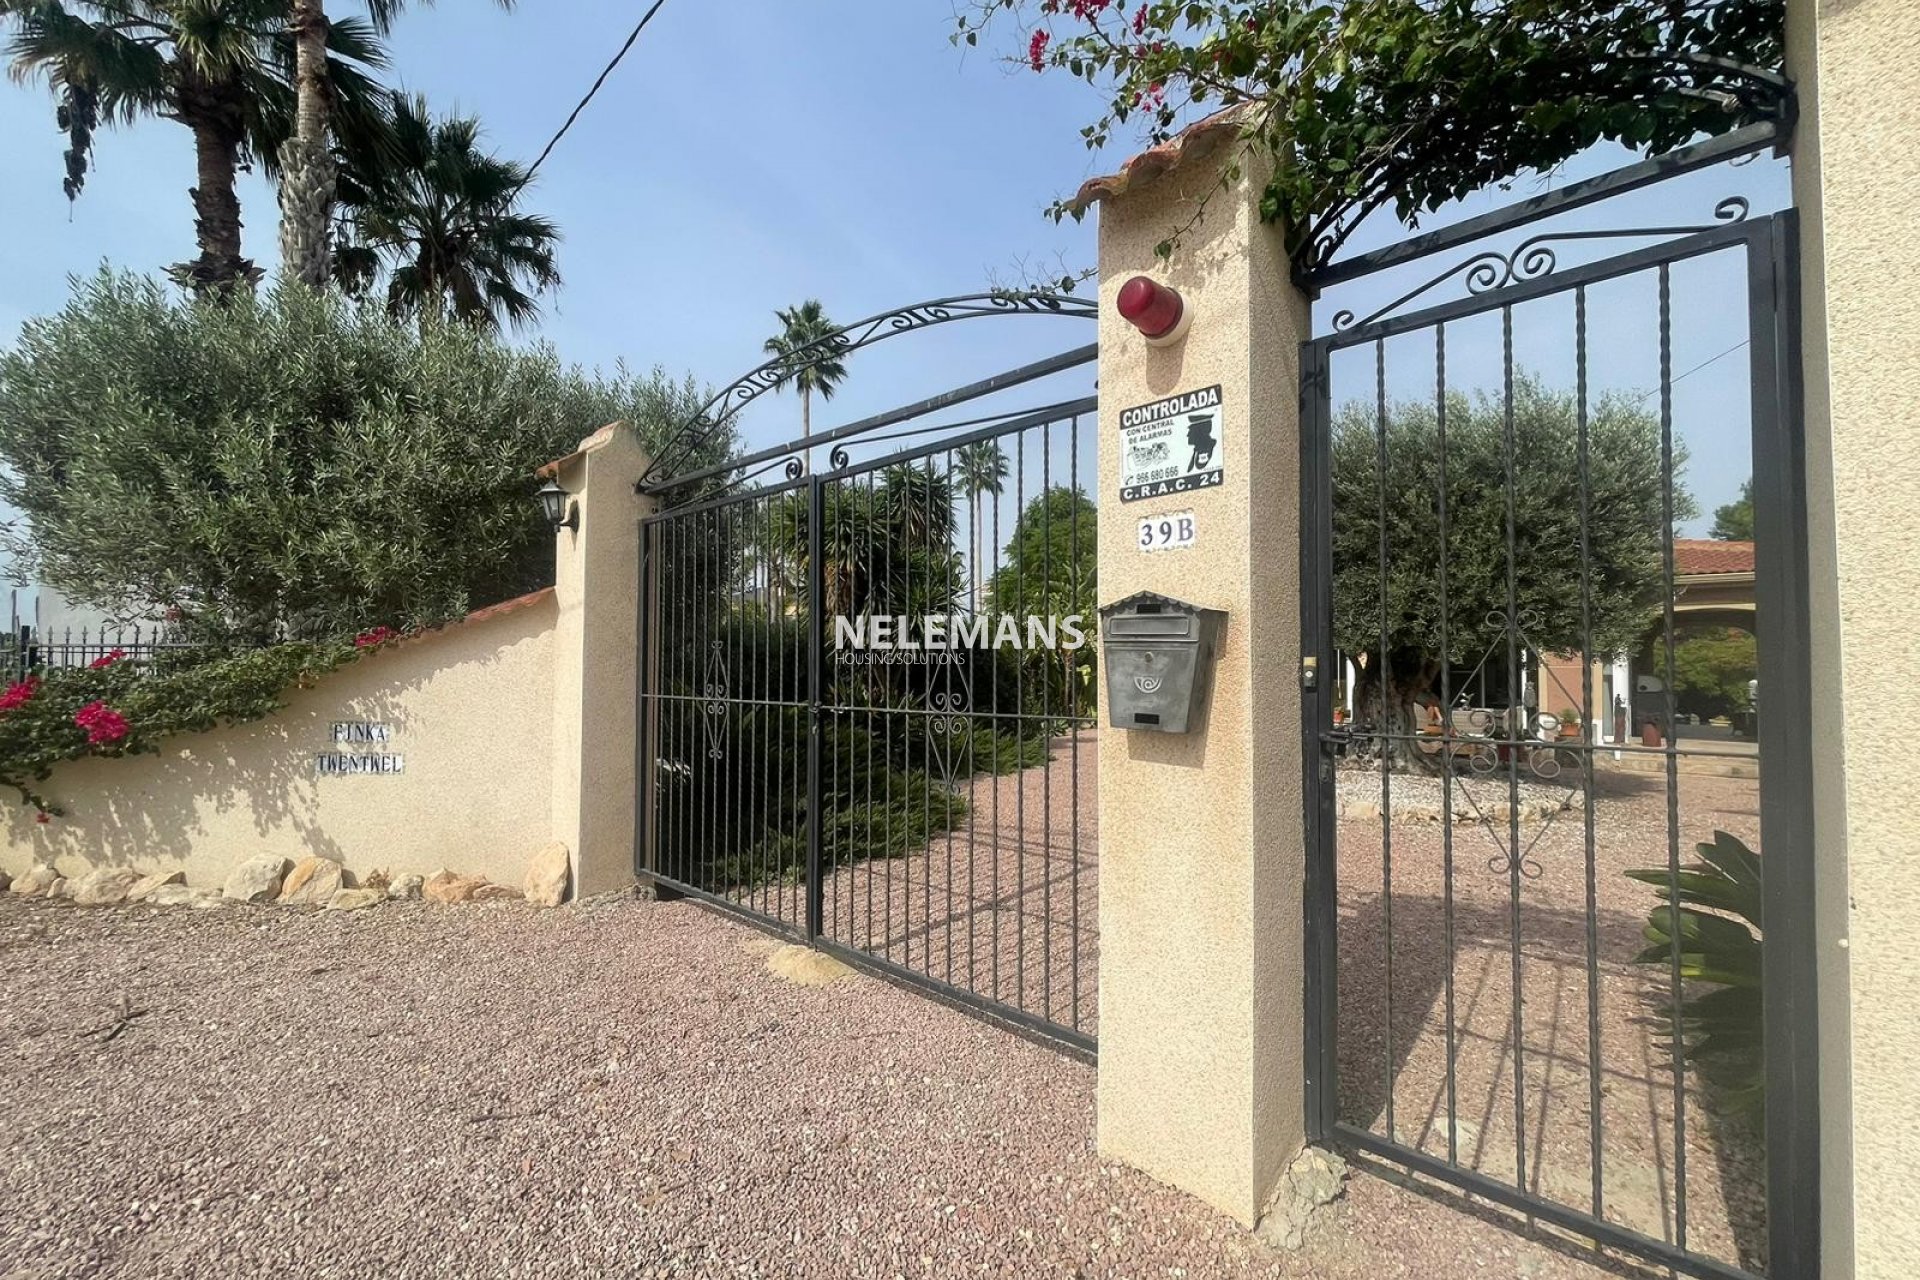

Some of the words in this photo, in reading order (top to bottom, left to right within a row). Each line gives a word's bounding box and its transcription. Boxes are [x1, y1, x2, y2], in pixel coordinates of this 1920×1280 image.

[1122, 388, 1218, 427] CONTROLADA
[1126, 428, 1141, 437] CON
[1142, 419, 1174, 433] CENTRAL
[1128, 436, 1138, 444] DE
[1139, 429, 1172, 442] ALARMAS
[1123, 479, 1192, 500] C.R.A.C.
[1199, 471, 1220, 486] 24
[1141, 518, 1194, 546] 39B
[334, 724, 386, 741] FINKA
[317, 754, 402, 773] TWENTWEL
